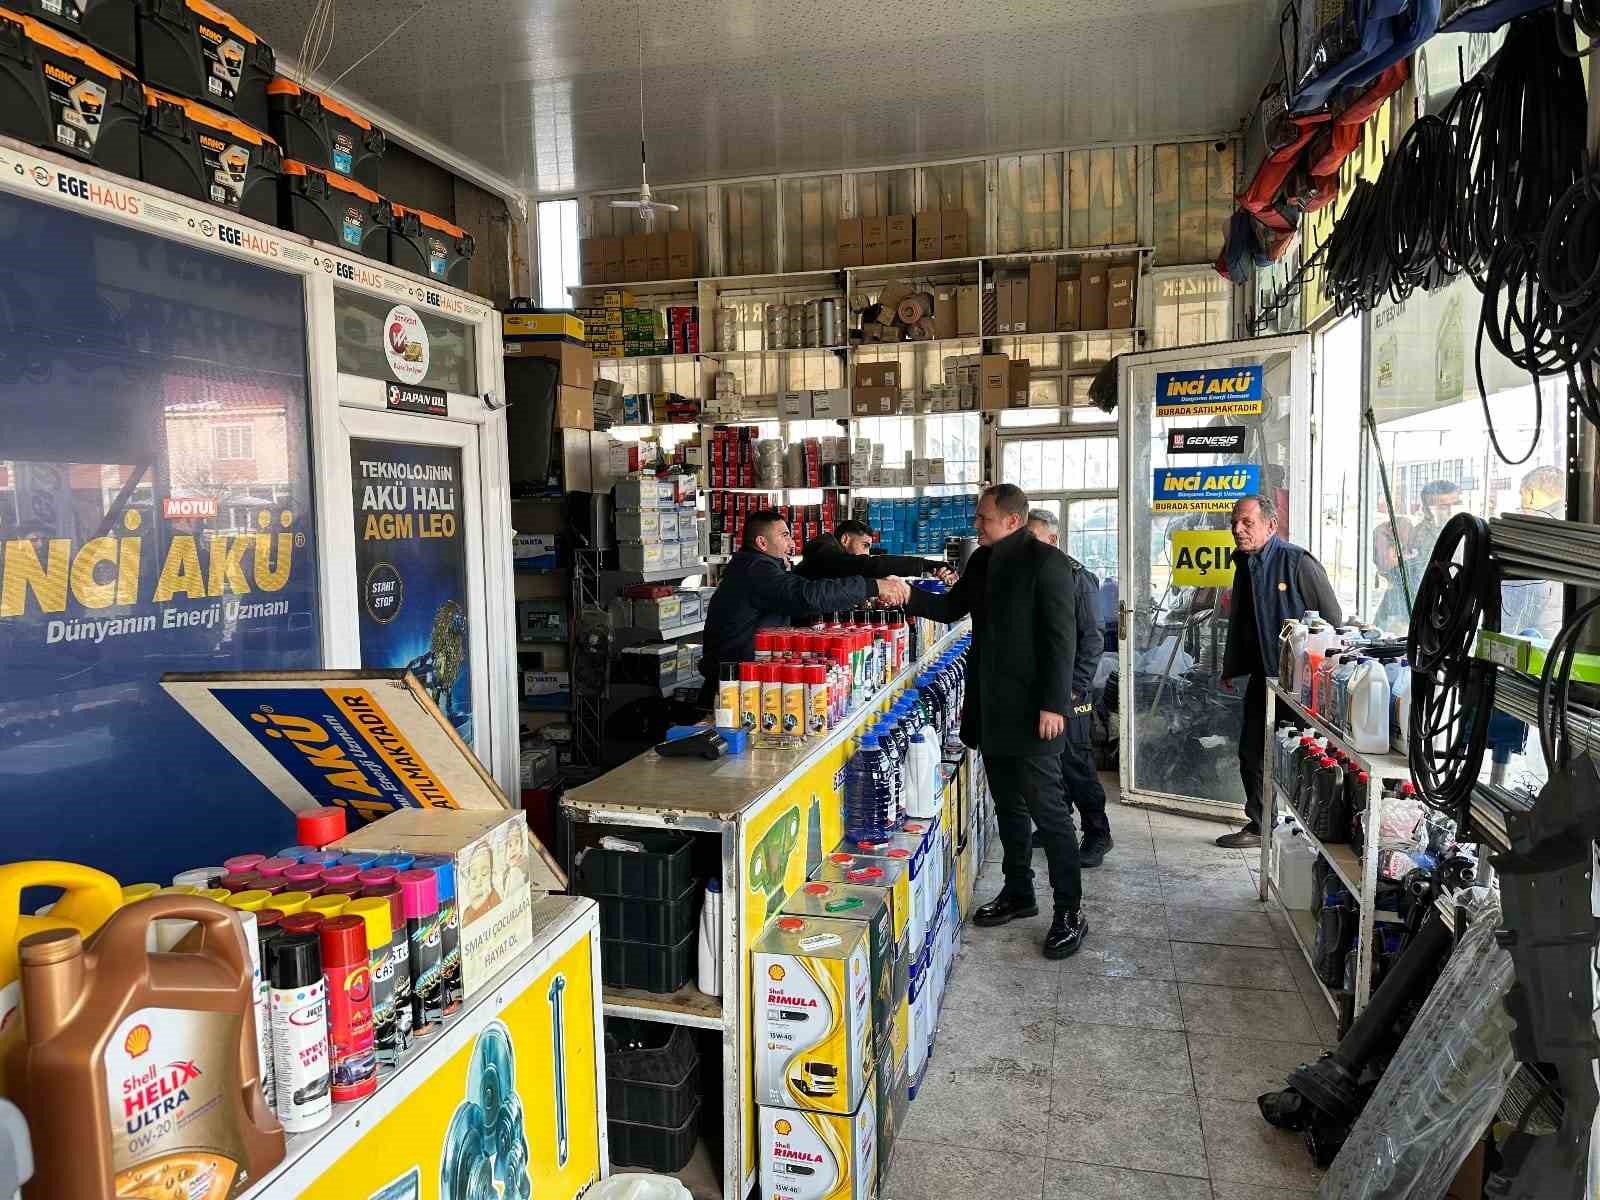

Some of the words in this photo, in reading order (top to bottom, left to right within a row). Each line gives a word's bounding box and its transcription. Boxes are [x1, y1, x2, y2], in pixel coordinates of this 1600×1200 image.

[1167, 374, 1205, 396] İNCİ
[1206, 372, 1250, 394] AKÜ
[401, 391, 431, 405] JAPAN
[432, 396, 444, 407] OIL
[1158, 406, 1191, 416] BURADA
[1191, 403, 1258, 414] SATILMAKTADIR
[1187, 436, 1239, 445] GENESIS
[360, 460, 453, 481] TEKNOLOJİNİN
[1163, 471, 1202, 491] İNCİ
[1202, 470, 1247, 490] AKÜ
[362, 481, 407, 511] AKÜ
[413, 486, 455, 511] HALİ
[1155, 502, 1188, 510] BURADA
[167, 499, 217, 515] MOTUL
[364, 513, 413, 541] AGM
[418, 513, 457, 539] LEO
[0, 509, 142, 617] NCİ
[153, 510, 293, 602] AKÜ
[372, 580, 396, 593] START
[374, 595, 394, 608] STOP
[47, 614, 156, 645] Dünyanın
[162, 604, 221, 629] Enerji
[223, 600, 290, 623] Uzmanı
[250, 711, 383, 798] AKÜ
[342, 695, 457, 810] ATILMAKTADIR
[767, 994, 818, 1008] RIMULA
[123, 1063, 157, 1095] Shell
[123, 1059, 202, 1118] HELIX
[126, 1089, 190, 1135] ULTRA
[128, 1119, 172, 1153] 0W-20
[774, 1141, 791, 1149] Shell
[773, 1148, 824, 1163] RIMULA
